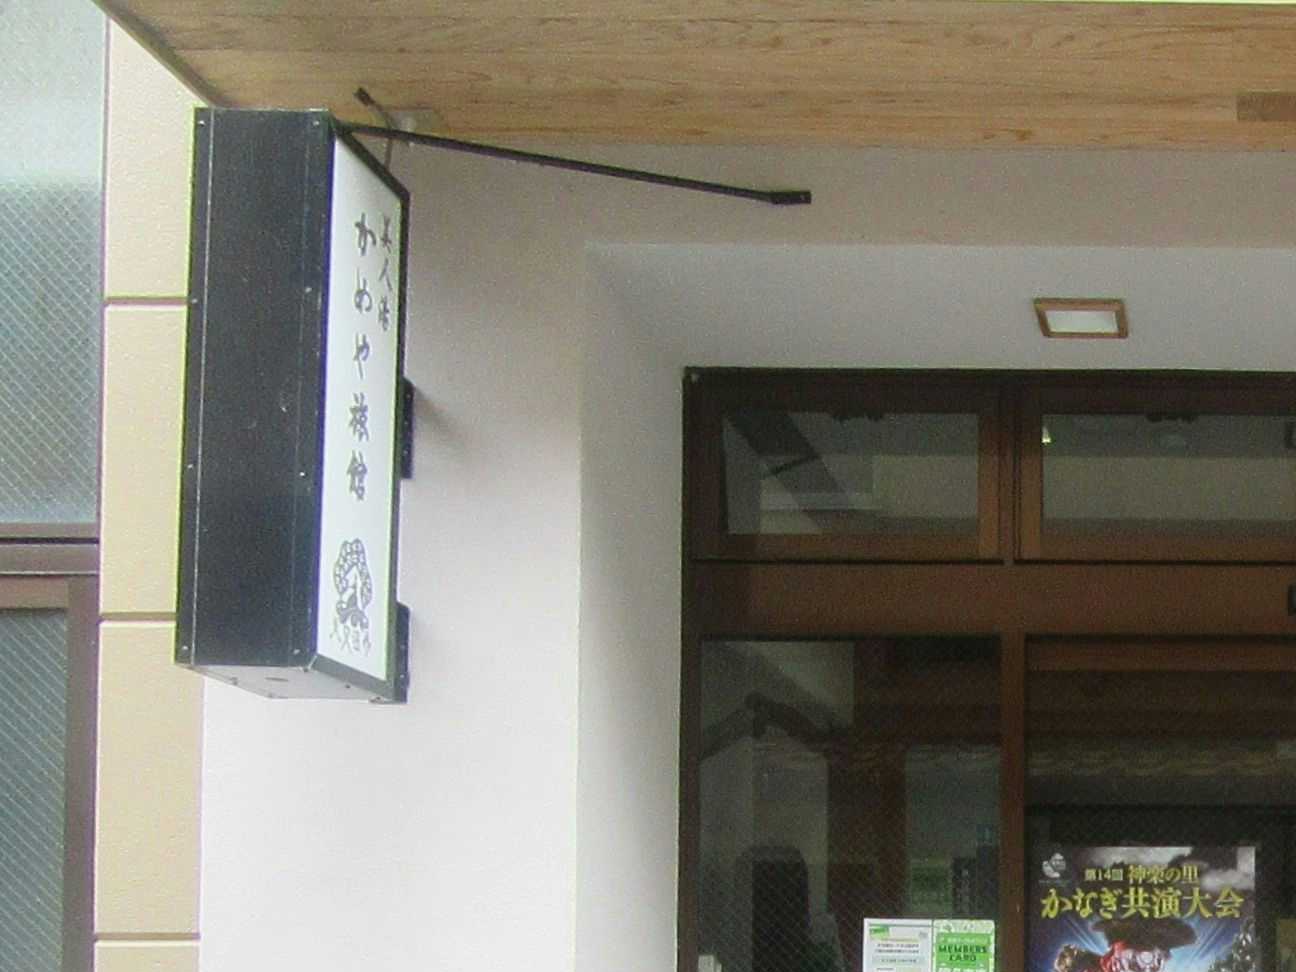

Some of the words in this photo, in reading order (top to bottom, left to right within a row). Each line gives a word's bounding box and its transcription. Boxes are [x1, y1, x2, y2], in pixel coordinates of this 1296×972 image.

[347, 212, 377, 500] かめや旅館
[1040, 886, 1245, 920] かなぎ共演大会
